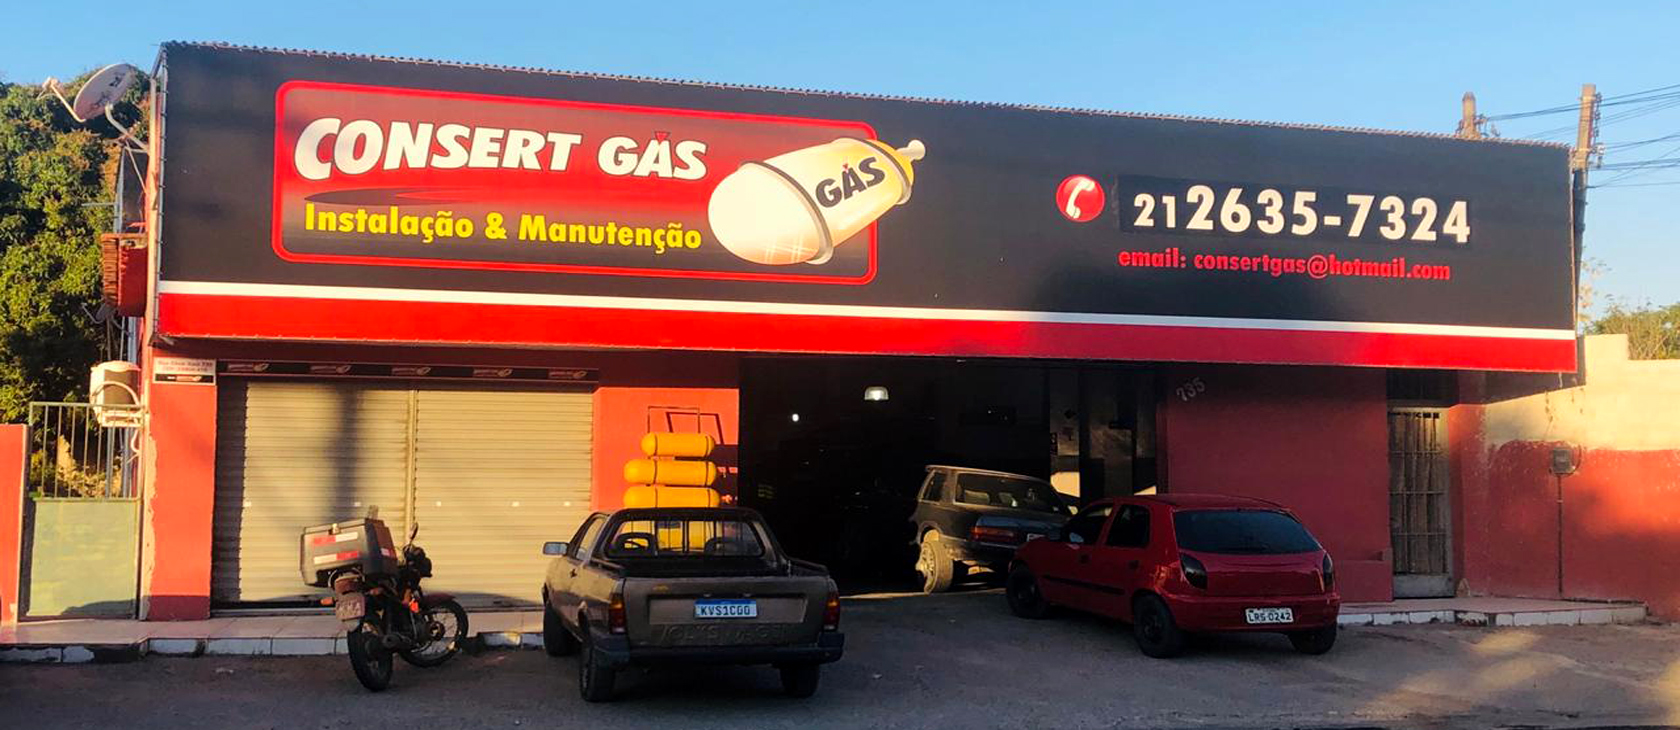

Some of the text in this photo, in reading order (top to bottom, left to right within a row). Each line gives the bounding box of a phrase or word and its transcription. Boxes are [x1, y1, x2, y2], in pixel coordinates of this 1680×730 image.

[294, 117, 583, 180] CONSERT
[305, 203, 702, 254] Instalação & Manutenção
[1186, 184, 1471, 243] 2635-7324
[1118, 247, 1451, 280] email: consertgas@hotmail.com
